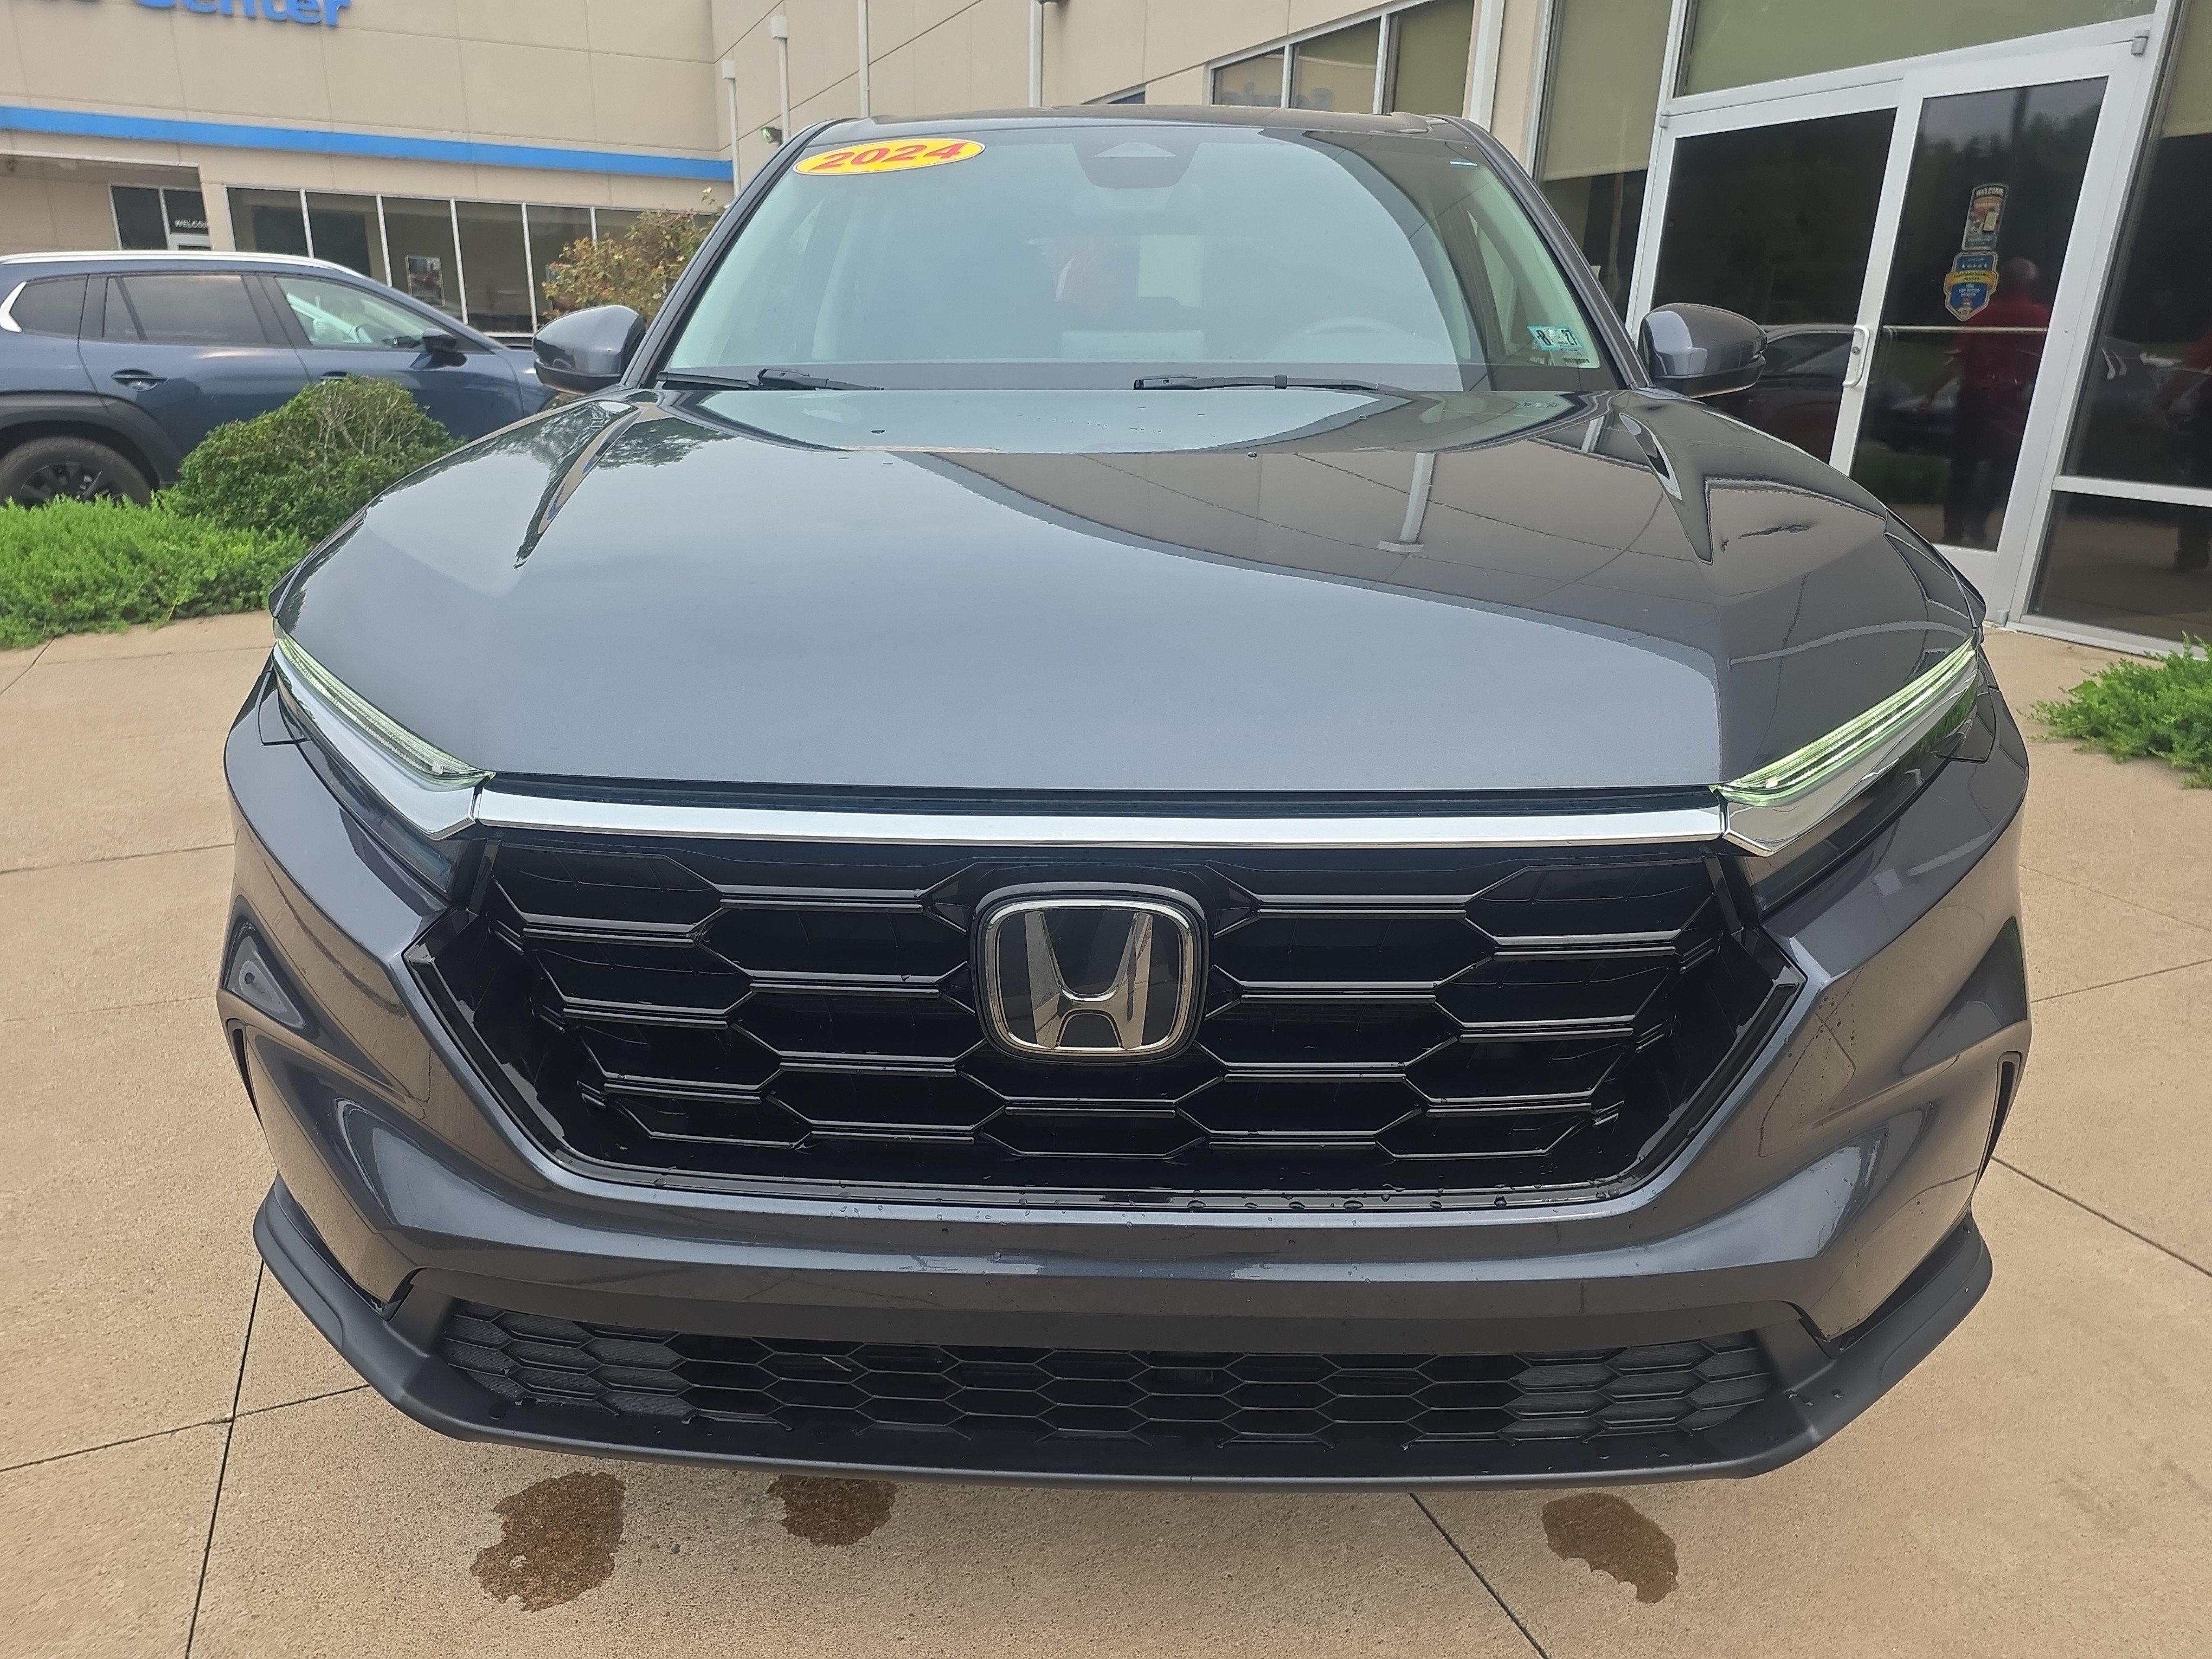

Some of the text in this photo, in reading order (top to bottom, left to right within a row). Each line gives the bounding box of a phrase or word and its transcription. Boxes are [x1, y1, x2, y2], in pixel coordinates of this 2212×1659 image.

[137, 0, 351, 27] nter
[809, 143, 967, 171] 2024
[1976, 187, 2004, 197] WELCOME
